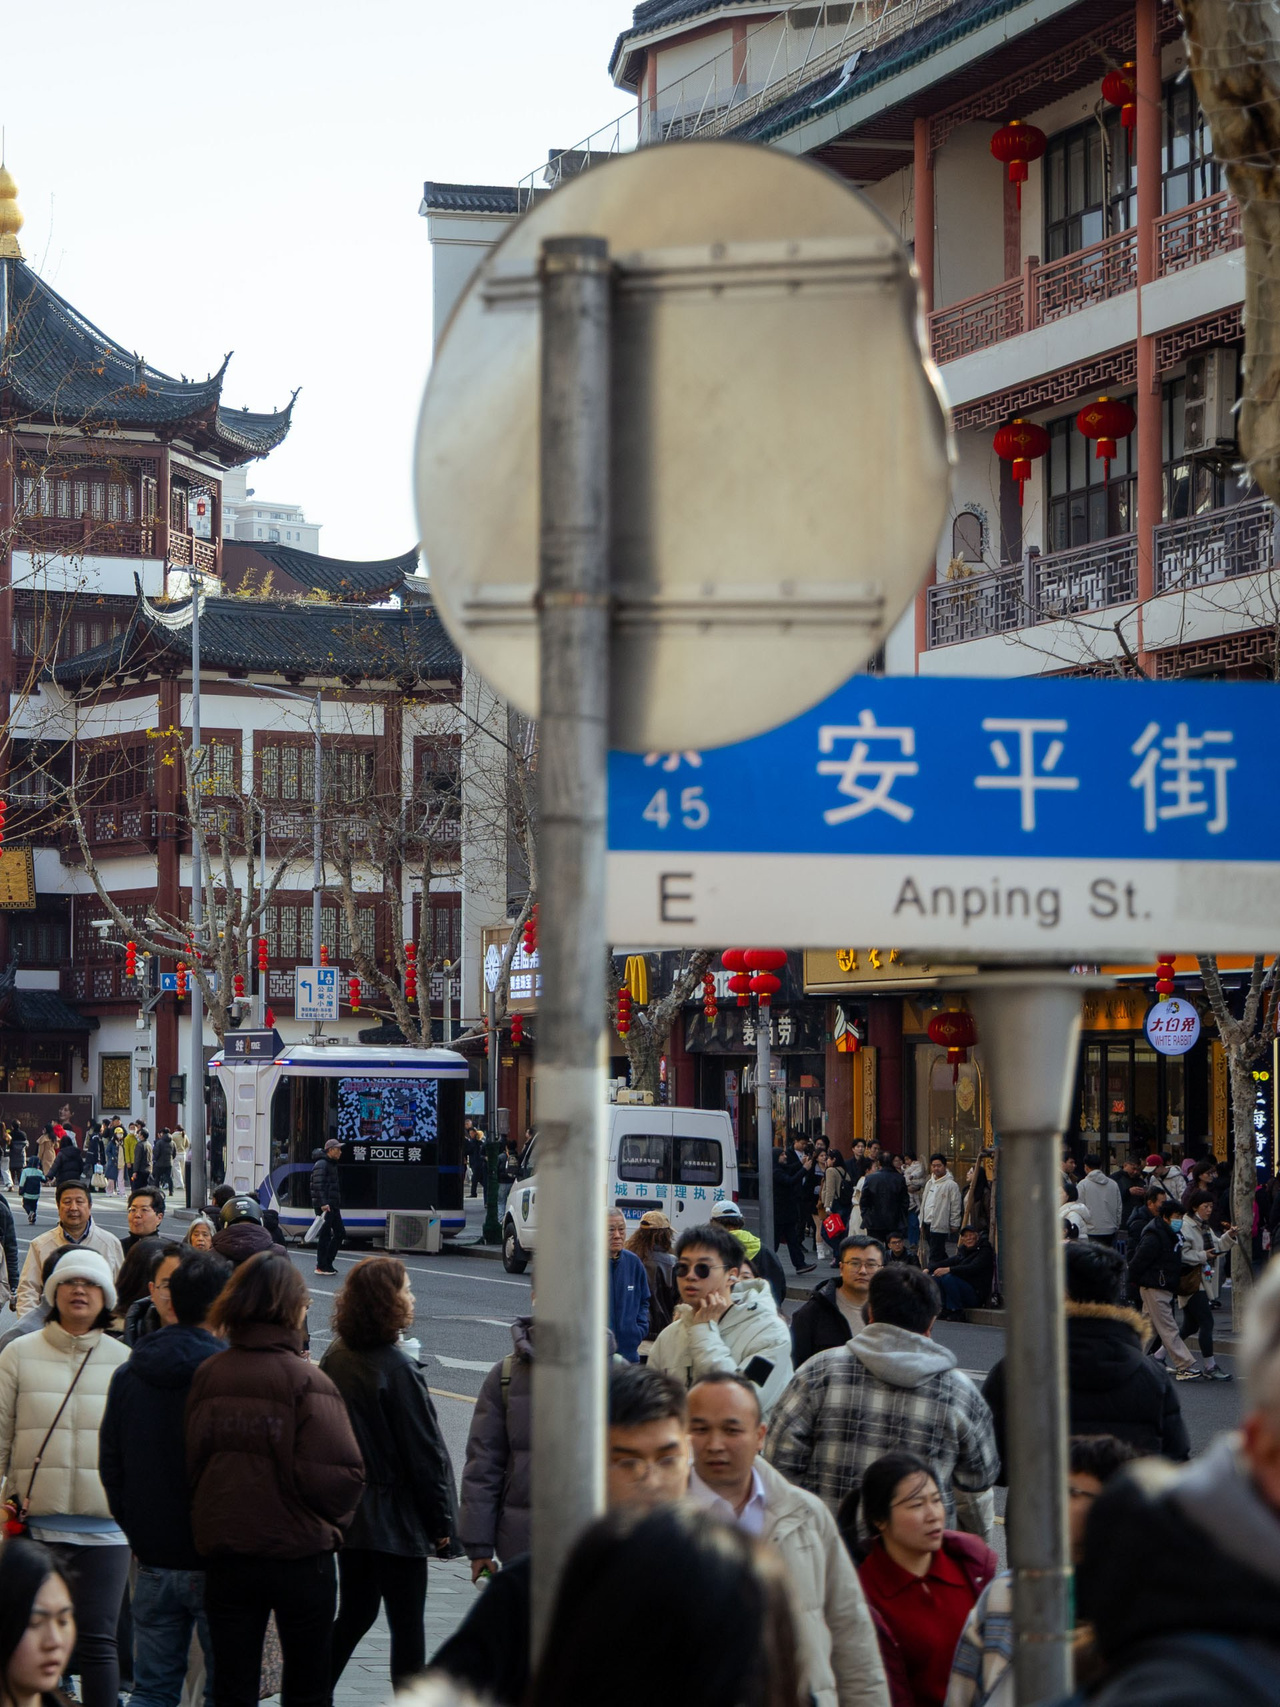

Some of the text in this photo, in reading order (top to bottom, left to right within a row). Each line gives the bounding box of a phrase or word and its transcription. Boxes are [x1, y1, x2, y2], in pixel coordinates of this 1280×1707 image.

[816, 709, 1238, 834] 安平街
[641, 786, 711, 831] 45
[658, 872, 696, 923] E
[893, 876, 1152, 928] Anping St.
[743, 1016, 792, 1046] 麦劳
[1150, 1017, 1196, 1033] 大白兔
[1155, 1034, 1193, 1047] WHITE RABBIT
[353, 1146, 422, 1161] 警 POLICE 察
[614, 1182, 726, 1202] 城市管理执法
